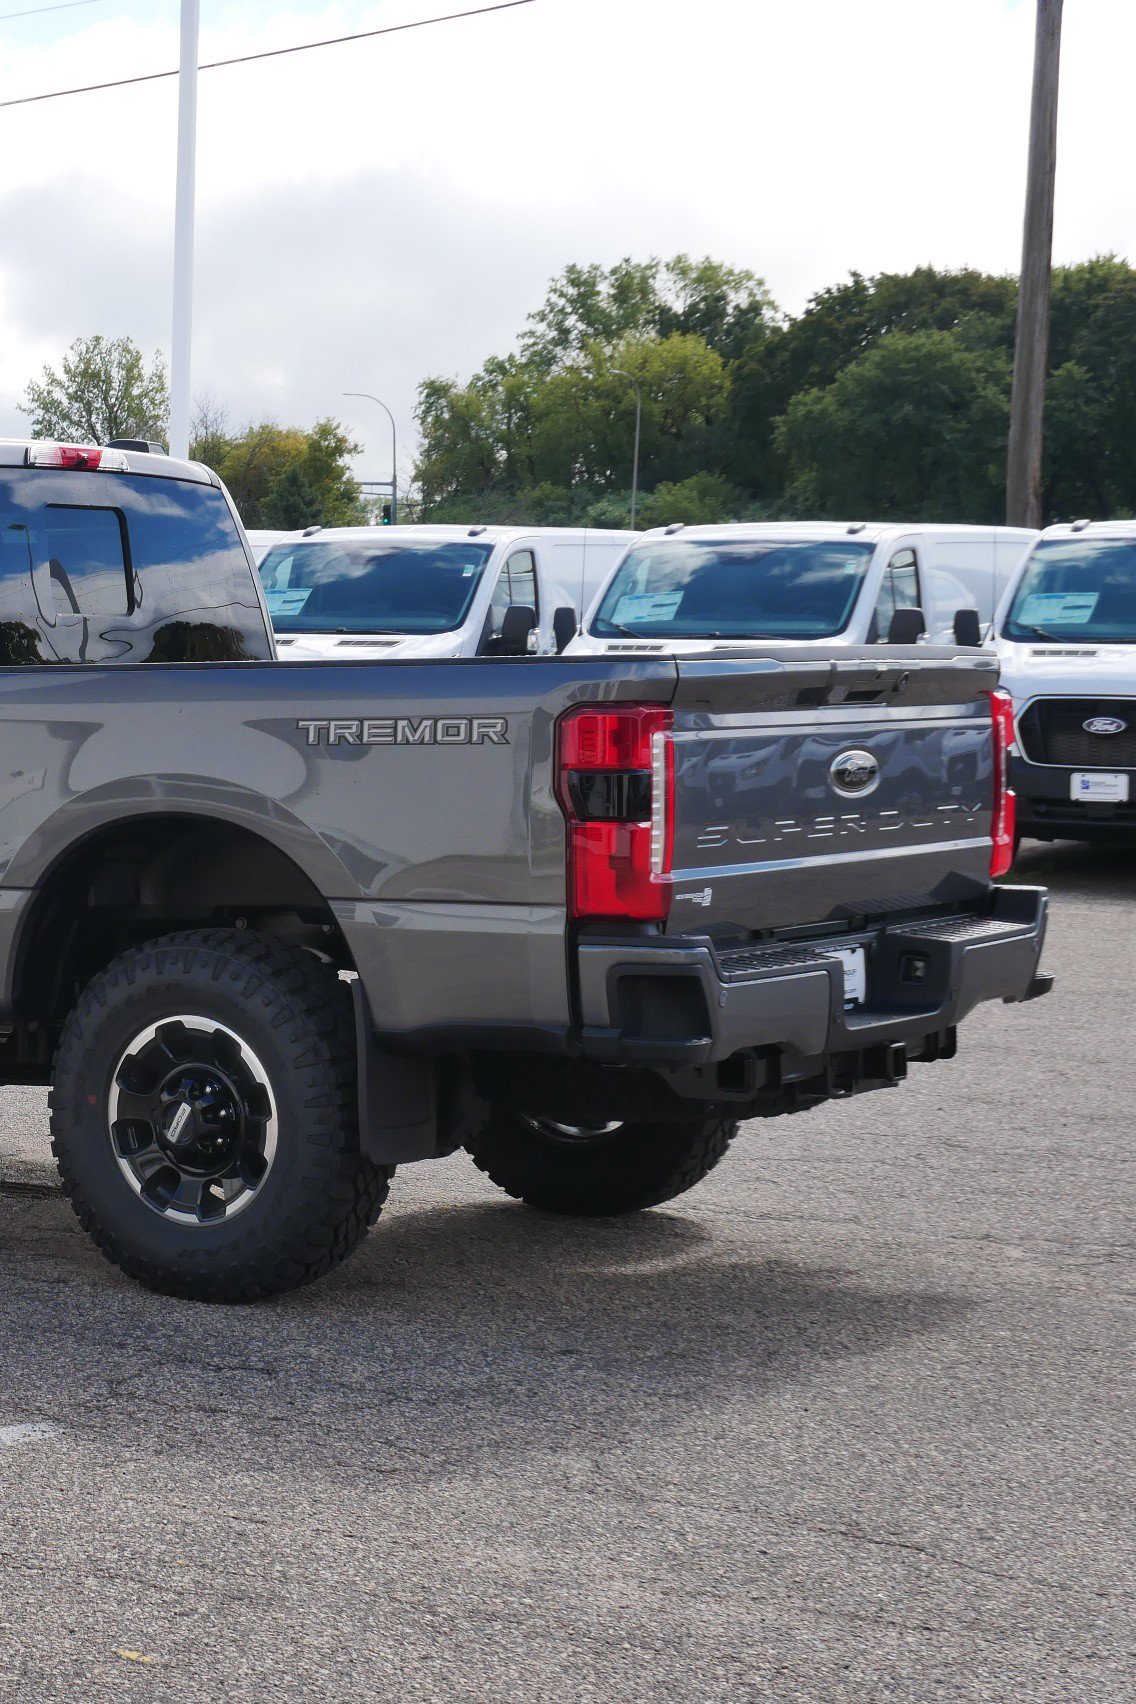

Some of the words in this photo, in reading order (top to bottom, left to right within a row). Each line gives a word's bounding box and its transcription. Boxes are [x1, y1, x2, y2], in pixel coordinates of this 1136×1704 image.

[297, 716, 512, 746] TREMOR
[1090, 720, 1119, 731] Ford
[171, 1107, 186, 1137] FORD
